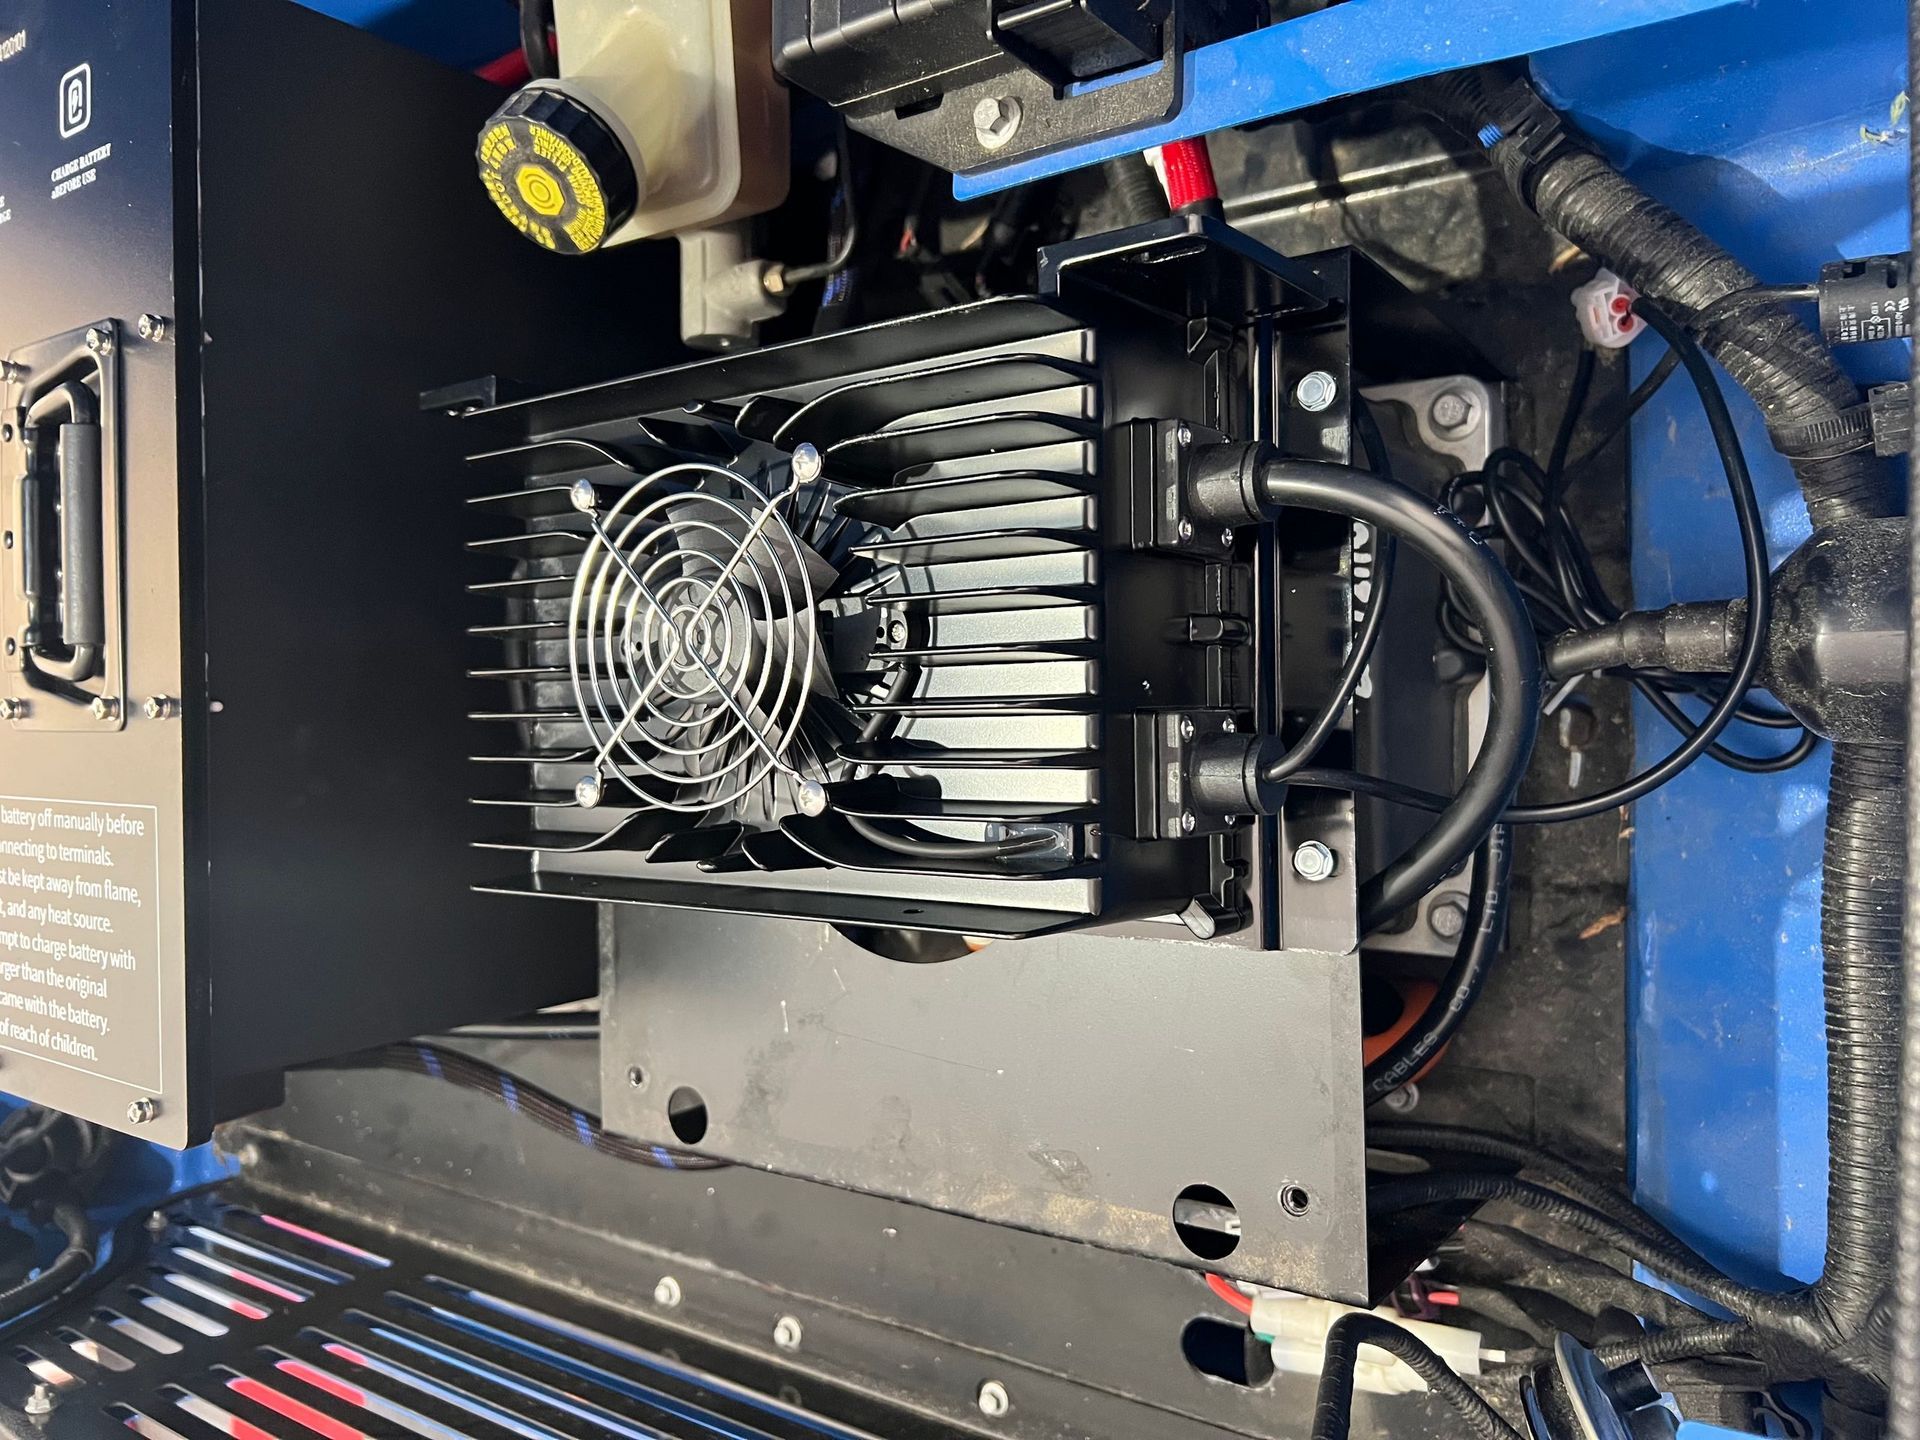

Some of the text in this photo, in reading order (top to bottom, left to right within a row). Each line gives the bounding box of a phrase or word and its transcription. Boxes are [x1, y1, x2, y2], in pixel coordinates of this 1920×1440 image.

[1, 804, 145, 837] battery off manually before
[0, 839, 114, 867] nnecting to terminals.
[8, 866, 21, 887] be
[22, 868, 45, 893] kept
[46, 878, 74, 899] away
[75, 875, 102, 898] from
[104, 879, 142, 908] flame,
[7, 899, 26, 918] and
[28, 904, 47, 926] any
[48, 903, 72, 926] heat
[73, 912, 114, 933] source.
[20, 932, 31, 950] to
[32, 933, 67, 961] charge
[69, 939, 108, 970] battery
[110, 948, 136, 971] with
[21, 961, 45, 984] than
[46, 967, 65, 988] the
[66, 973, 107, 999] original
[24, 994, 48, 1016] with
[48, 999, 67, 1021] the
[67, 1002, 111, 1036] battery.
[0, 1017, 98, 1061] of reach of children.
[1372, 1031, 1438, 1092] CABLES
